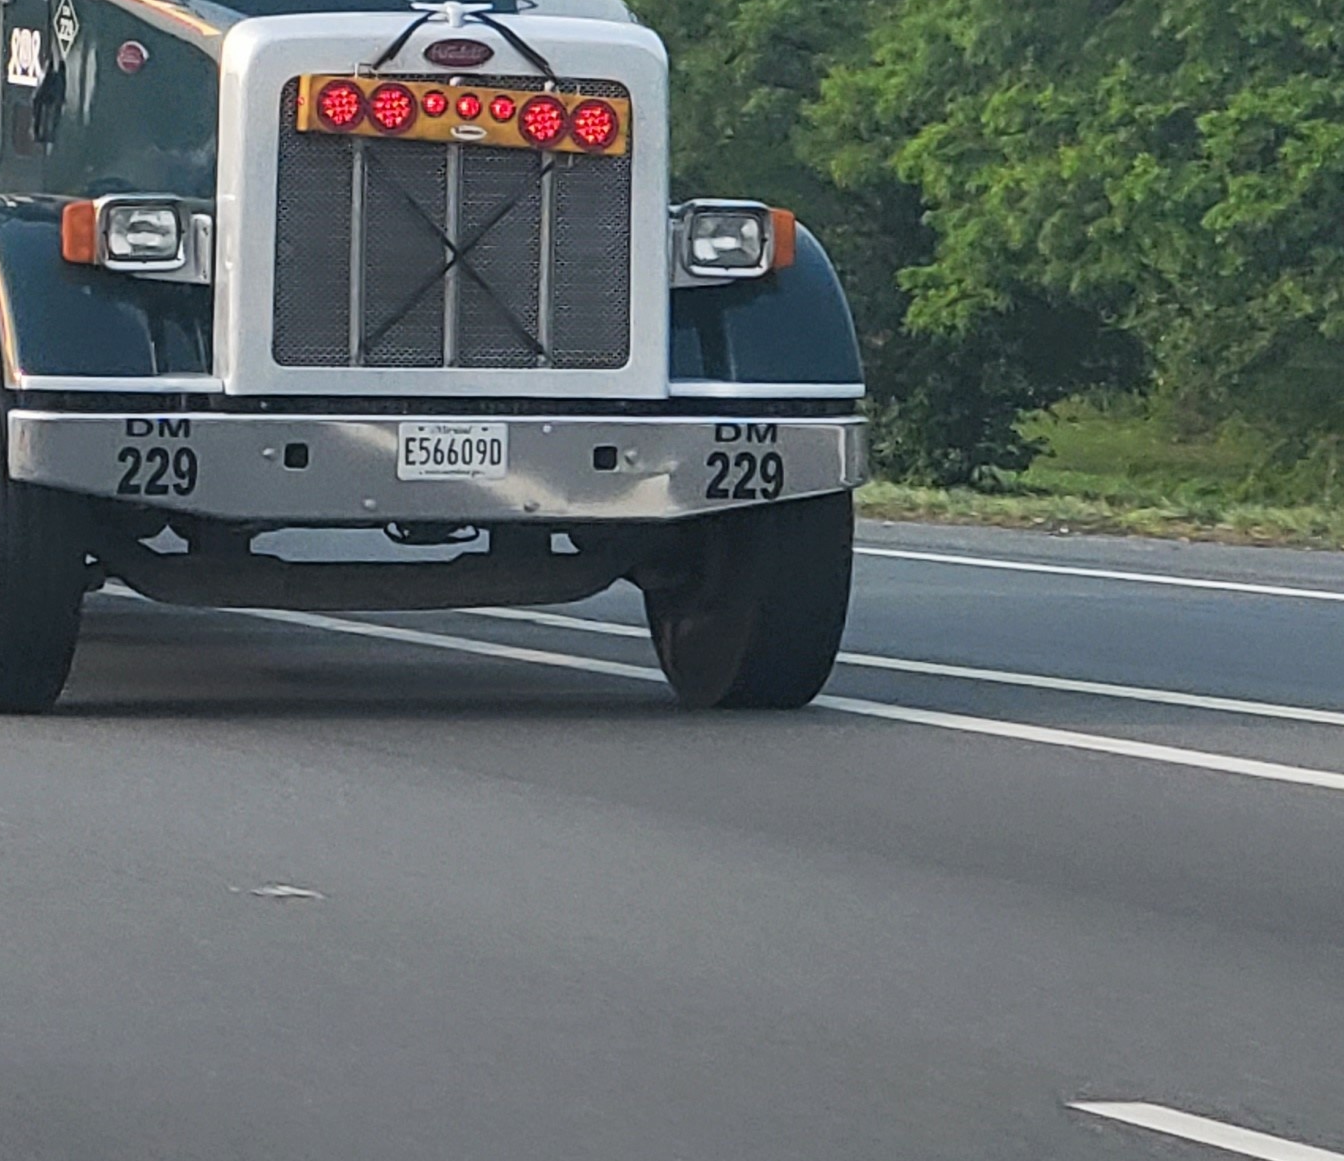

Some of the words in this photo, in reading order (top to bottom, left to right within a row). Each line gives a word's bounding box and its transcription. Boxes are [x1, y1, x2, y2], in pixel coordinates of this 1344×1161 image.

[126, 418, 191, 438] DM
[715, 423, 778, 443] DM
[116, 446, 198, 497] 229
[705, 451, 784, 501] 229
